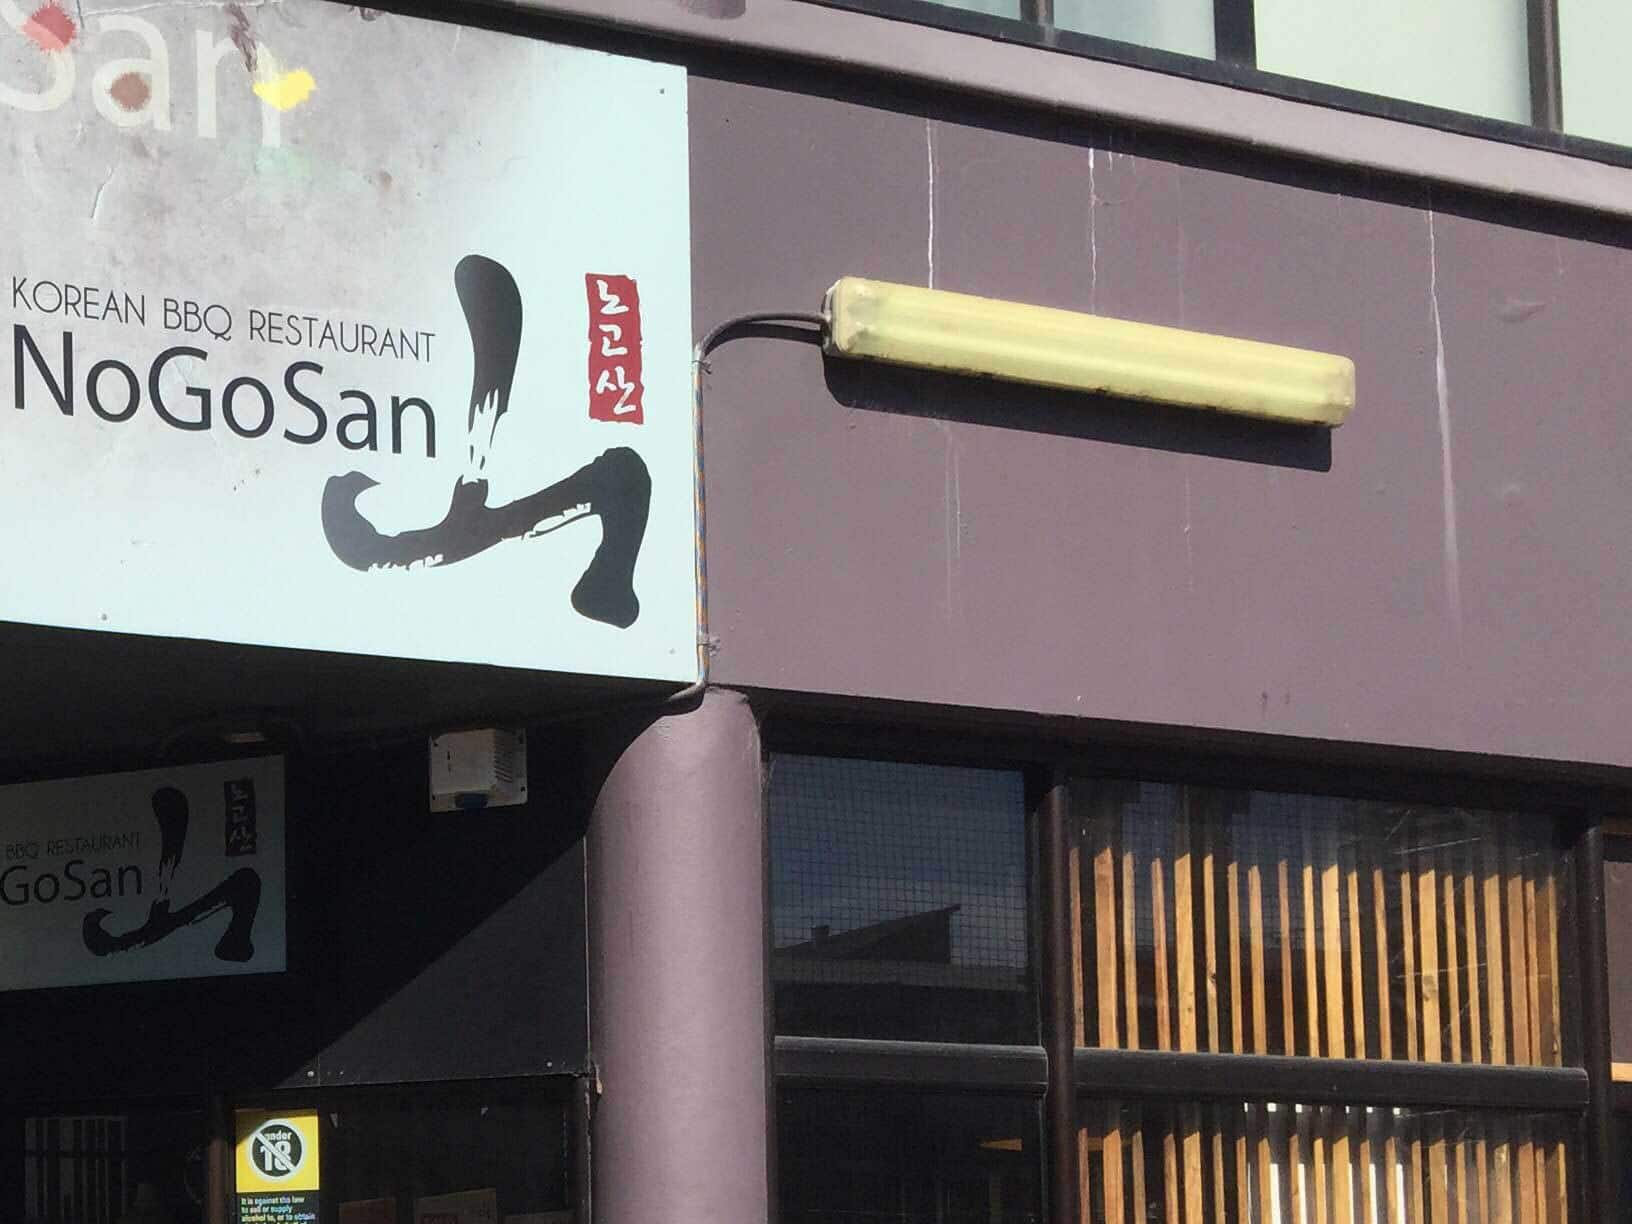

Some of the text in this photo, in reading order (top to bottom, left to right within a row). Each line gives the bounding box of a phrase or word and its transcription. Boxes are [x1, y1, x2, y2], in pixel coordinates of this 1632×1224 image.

[11, 275, 436, 364] KOREAN BBQ RESTAURANT
[591, 277, 640, 417] 노고산
[12, 322, 437, 459] NoGoSan
[4, 842, 41, 861] BBQ
[46, 831, 142, 856] RESTAURANT
